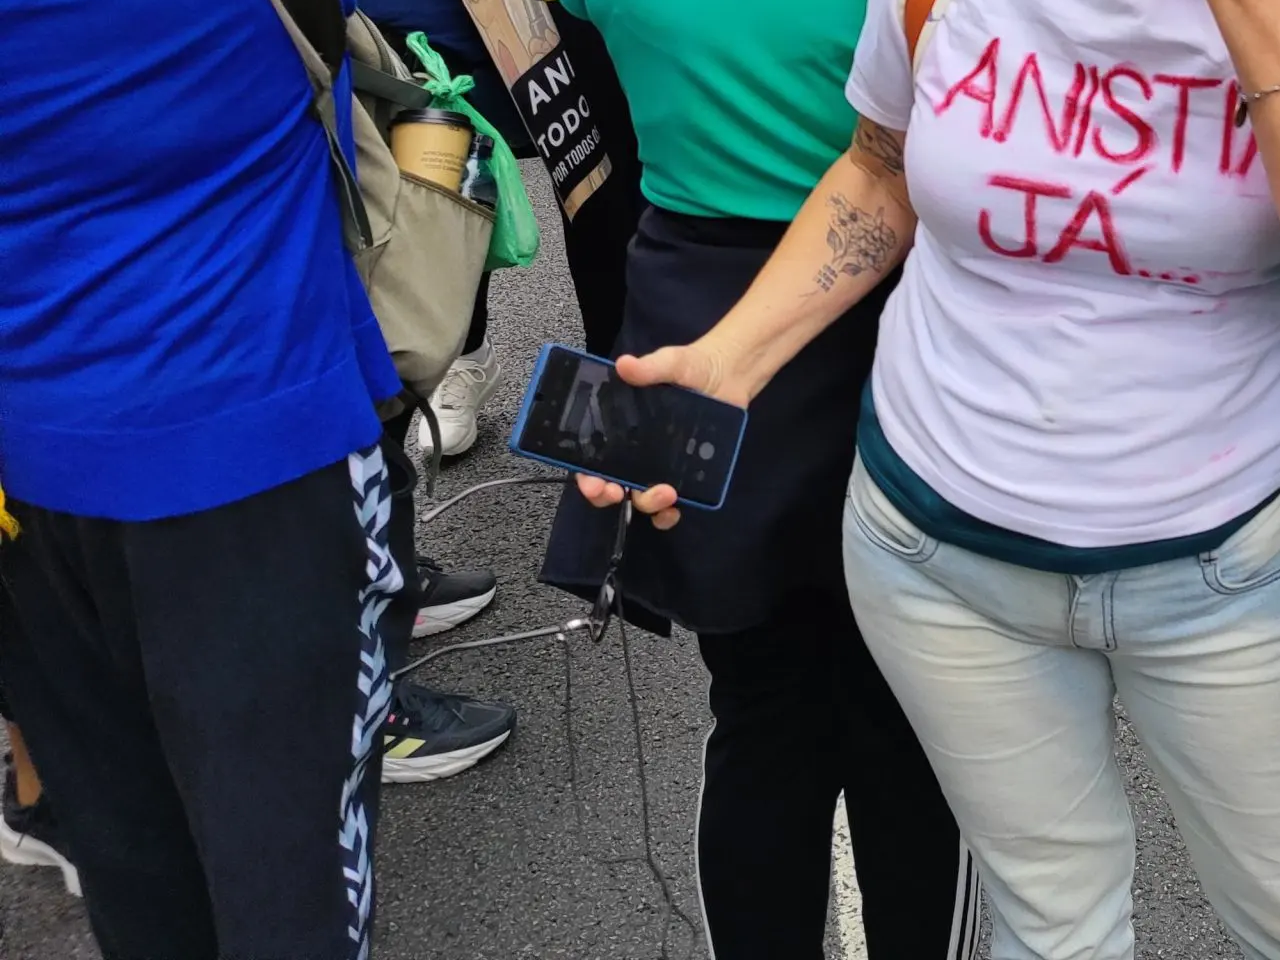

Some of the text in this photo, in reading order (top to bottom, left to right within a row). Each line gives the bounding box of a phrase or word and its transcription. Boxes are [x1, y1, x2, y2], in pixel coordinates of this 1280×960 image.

[537, 94, 590, 158] TODO
[551, 160, 569, 188] POR
[564, 134, 595, 170] TODOS
